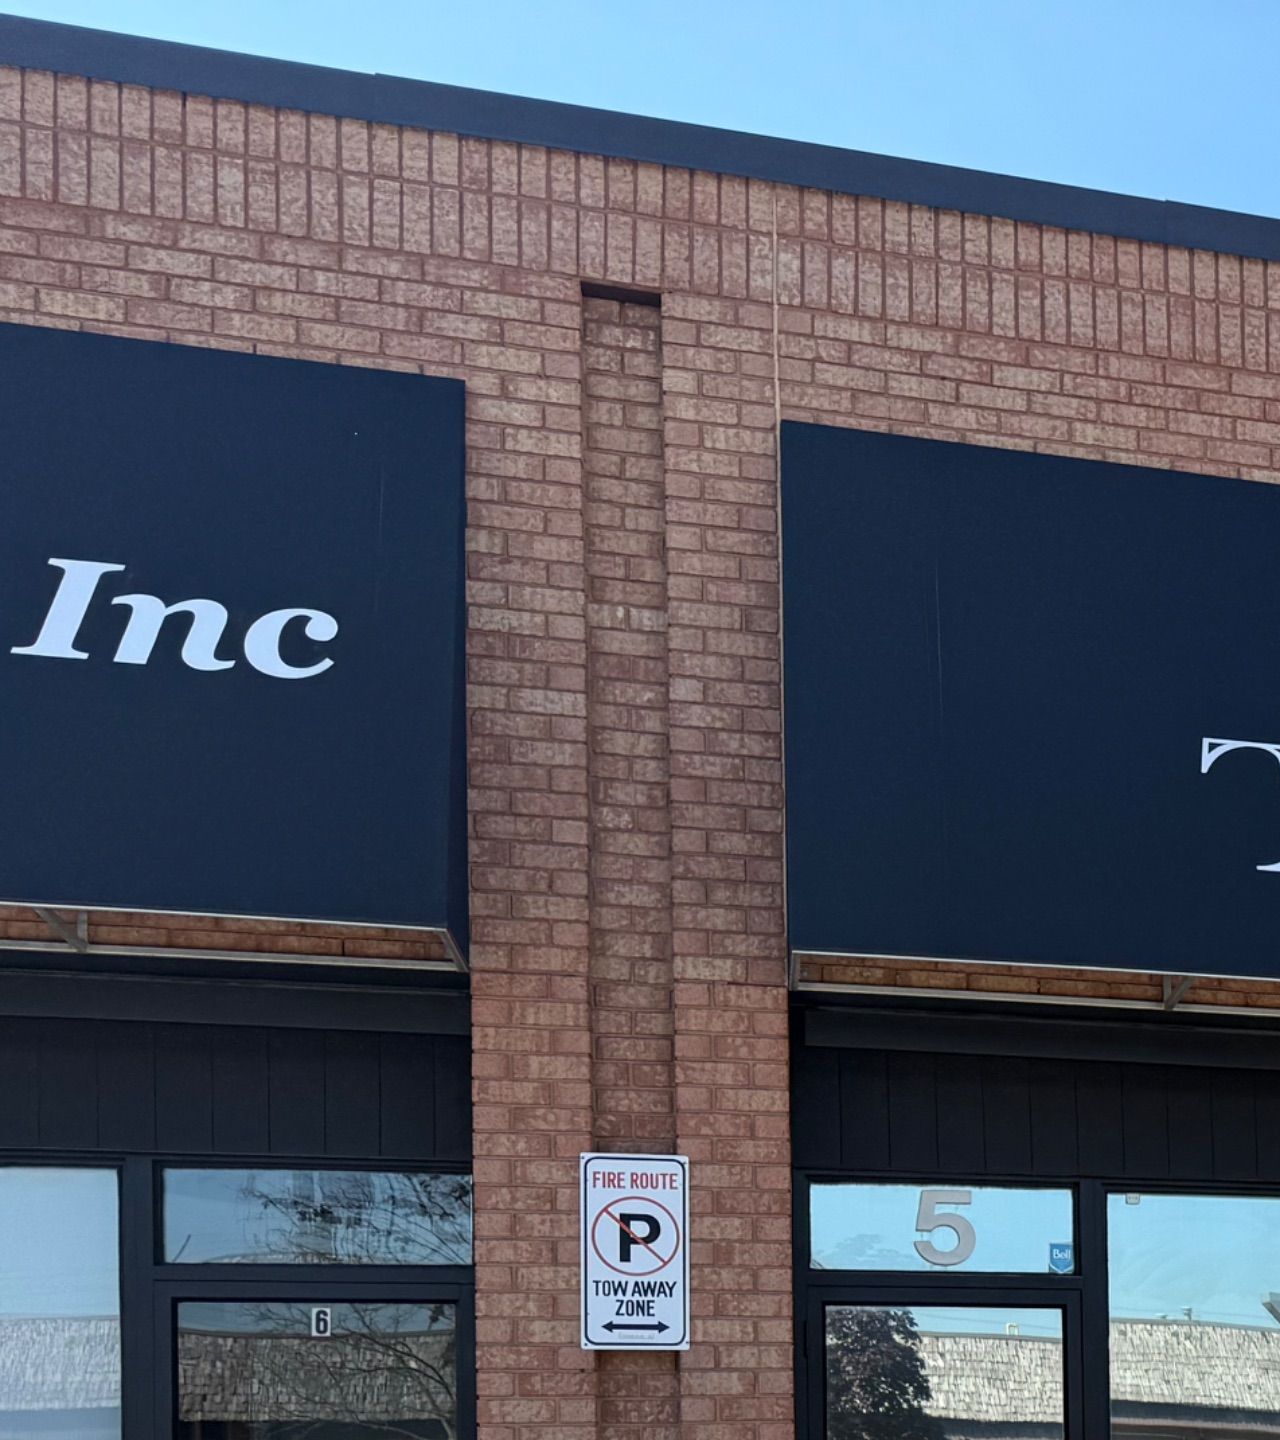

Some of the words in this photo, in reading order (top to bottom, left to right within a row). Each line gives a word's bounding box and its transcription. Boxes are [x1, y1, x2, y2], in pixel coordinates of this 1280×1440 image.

[11, 558, 338, 679] Inc
[592, 1171, 626, 1189] FIRE
[630, 1172, 678, 1190] ROUTE
[619, 1213, 661, 1263] P
[913, 1190, 977, 1267] 5
[593, 1280, 628, 1297] TOW
[632, 1281, 677, 1298] AWAY
[615, 1300, 656, 1317] ZONE
[316, 1310, 329, 1334] 6
